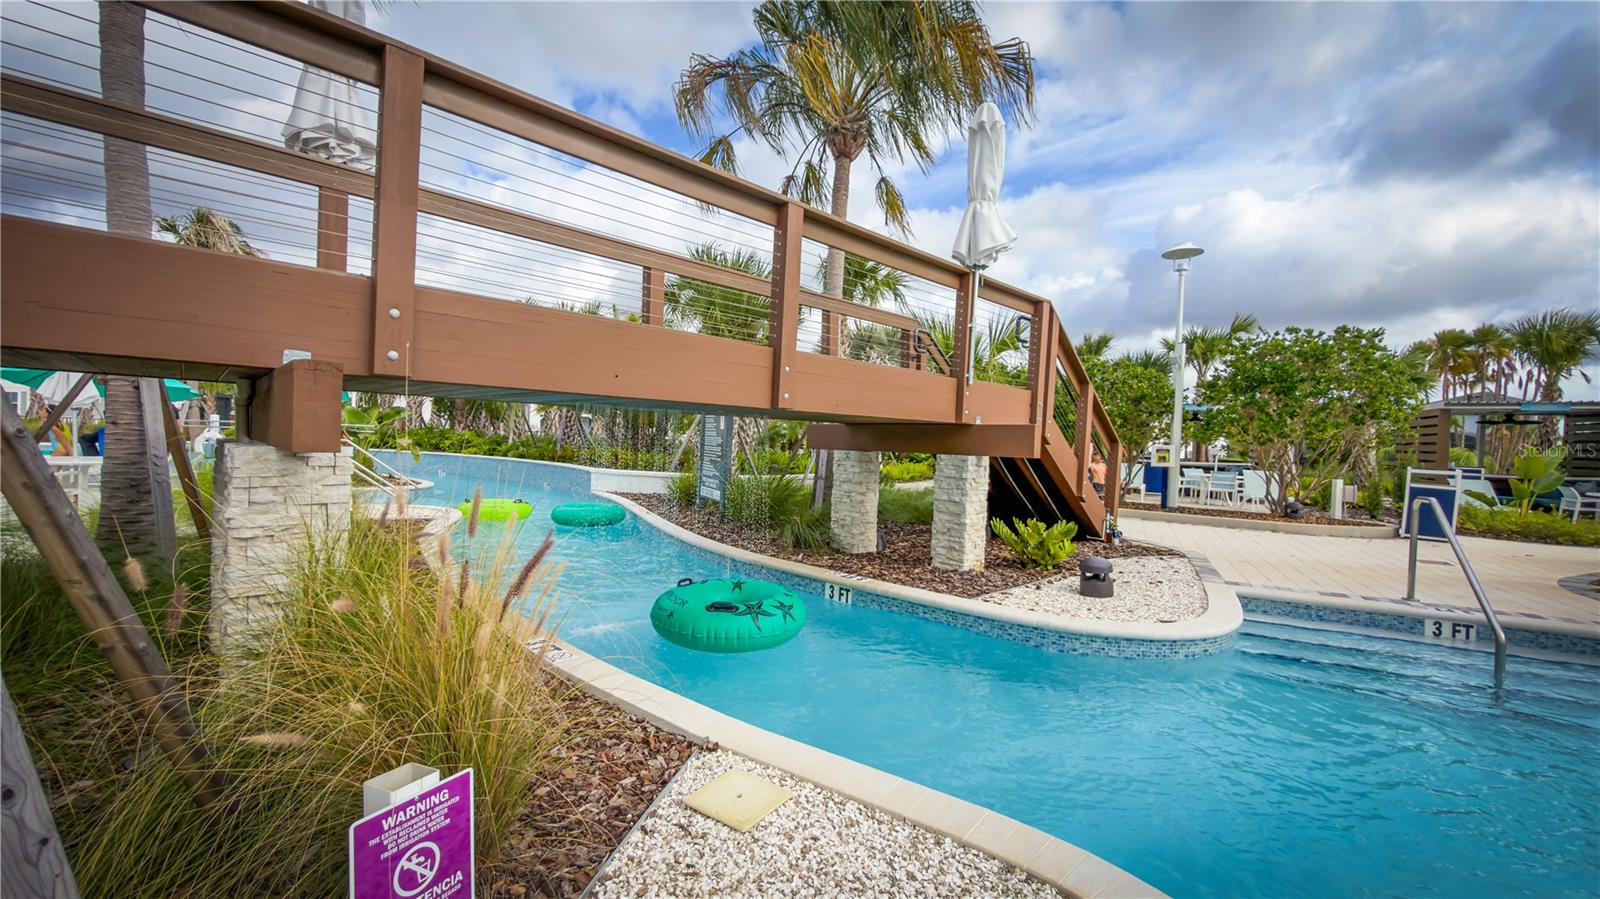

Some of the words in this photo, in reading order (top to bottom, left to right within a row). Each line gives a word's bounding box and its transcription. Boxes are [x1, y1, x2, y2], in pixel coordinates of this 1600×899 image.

[829, 584, 835, 599] 3
[838, 586, 851, 604] FT
[1432, 620, 1443, 637] 3
[1451, 622, 1474, 641] FT
[369, 836, 380, 847] THE
[382, 813, 426, 840] ESTABLISHMENT
[434, 796, 460, 813] IRRIGATED
[381, 789, 449, 831] WARNING
[383, 834, 398, 845] WITH
[399, 818, 430, 837] RECLAIMED
[431, 808, 448, 820] WATER
[381, 848, 397, 860] FROM
[399, 830, 430, 850] IRRIGATION
[431, 818, 450, 833] SYSTEM
[387, 841, 396, 849] DO
[397, 834, 409, 844] NOT
[410, 826, 426, 837] DRINK
[427, 815, 445, 828] WATER
